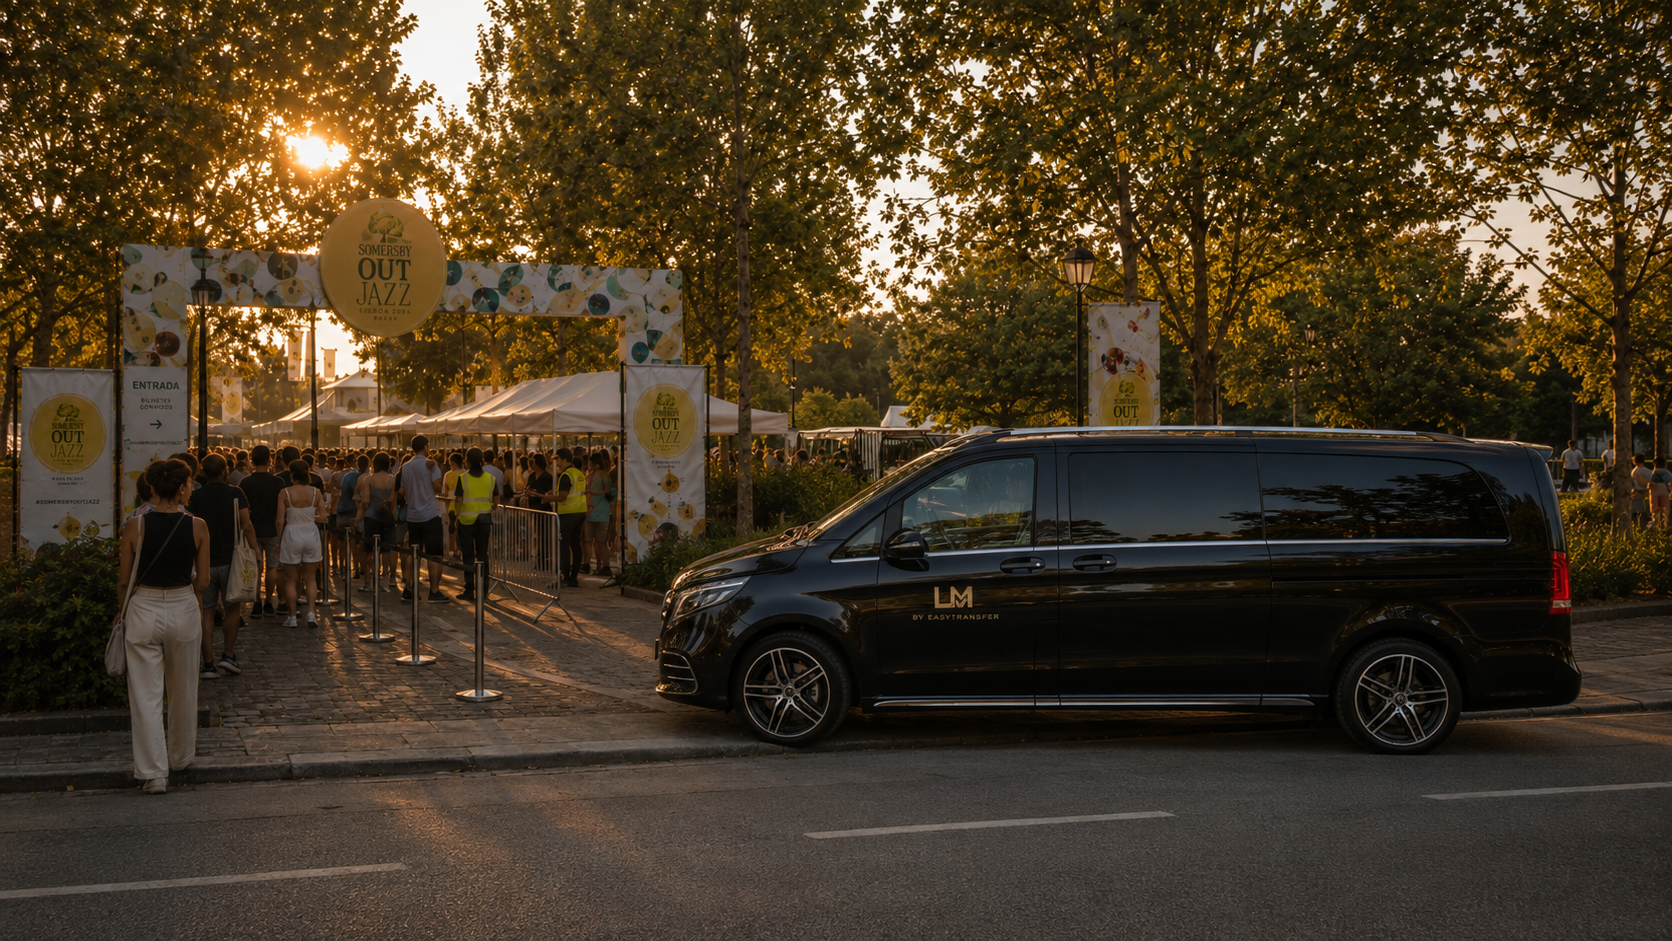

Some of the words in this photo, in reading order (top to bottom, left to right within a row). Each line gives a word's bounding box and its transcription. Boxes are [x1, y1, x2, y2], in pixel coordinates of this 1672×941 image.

[358, 243, 412, 257] SOMERSBY
[358, 257, 412, 281] OUT
[356, 282, 411, 306] JAZZ
[132, 381, 180, 390] ENTRADA
[1113, 405, 1139, 419] OUT
[651, 417, 680, 431] OUT
[51, 430, 85, 444] OUT
[651, 430, 681, 444] JAZZ
[50, 443, 85, 458] JAZZ
[933, 585, 974, 609] LM
[927, 613, 1000, 621] EASYTRANSFER
